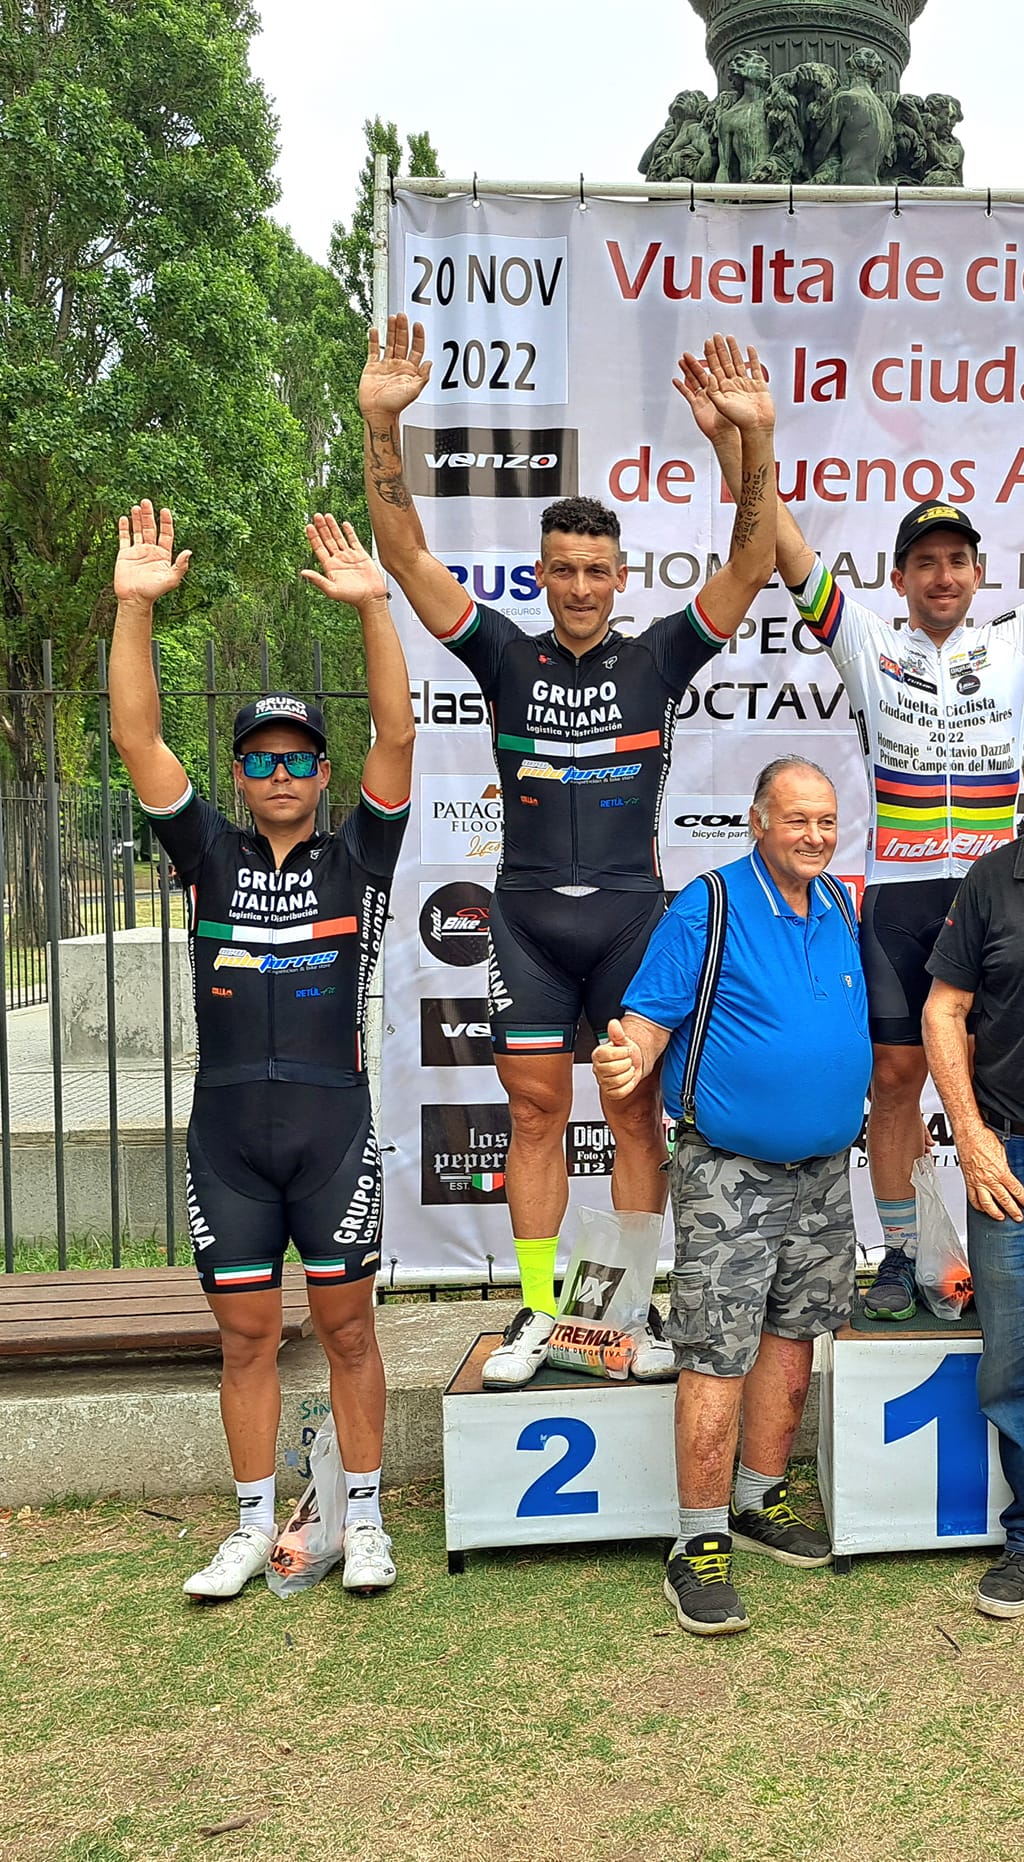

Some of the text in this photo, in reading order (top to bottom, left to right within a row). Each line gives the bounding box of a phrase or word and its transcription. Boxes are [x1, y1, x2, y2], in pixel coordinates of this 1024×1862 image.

[411, 255, 563, 305] 20 NOV
[606, 241, 834, 304] Vuelta
[858, 241, 944, 301] de
[441, 340, 537, 390] 2022
[793, 347, 847, 403] la
[424, 452, 558, 469] venzo
[608, 446, 695, 503] de
[720, 456, 976, 505] uenos
[255, 697, 307, 709] GRUPO
[532, 680, 617, 708] GRUPO
[675, 682, 856, 721] OCTAV
[896, 691, 996, 717] Vuelta Ciclista
[255, 704, 309, 716] ITALIANA
[526, 703, 623, 728] ITALIANA
[879, 699, 1013, 729] Ciudad de Buenos Aires
[877, 731, 920, 758] Homenaje
[929, 731, 964, 743] 2022
[880, 750, 909, 770] Primer
[968, 759, 984, 772] del
[986, 755, 1015, 771] Mundo
[431, 801, 501, 819] PATAG
[674, 814, 749, 828] COL
[451, 820, 503, 833] FLOO
[691, 830, 749, 840] bicycle part
[238, 868, 314, 893] GRUPO
[231, 890, 318, 912] ITALIANA
[264, 915, 270, 923] y
[441, 917, 481, 930] Bike
[573, 1126, 616, 1150] Digit
[433, 1152, 508, 1173] peper
[576, 1151, 598, 1161] Foto
[449, 1182, 471, 1191] EST.
[333, 1175, 375, 1246] GRUPO
[884, 1352, 988, 1536] 1
[516, 1416, 599, 1518] 2
